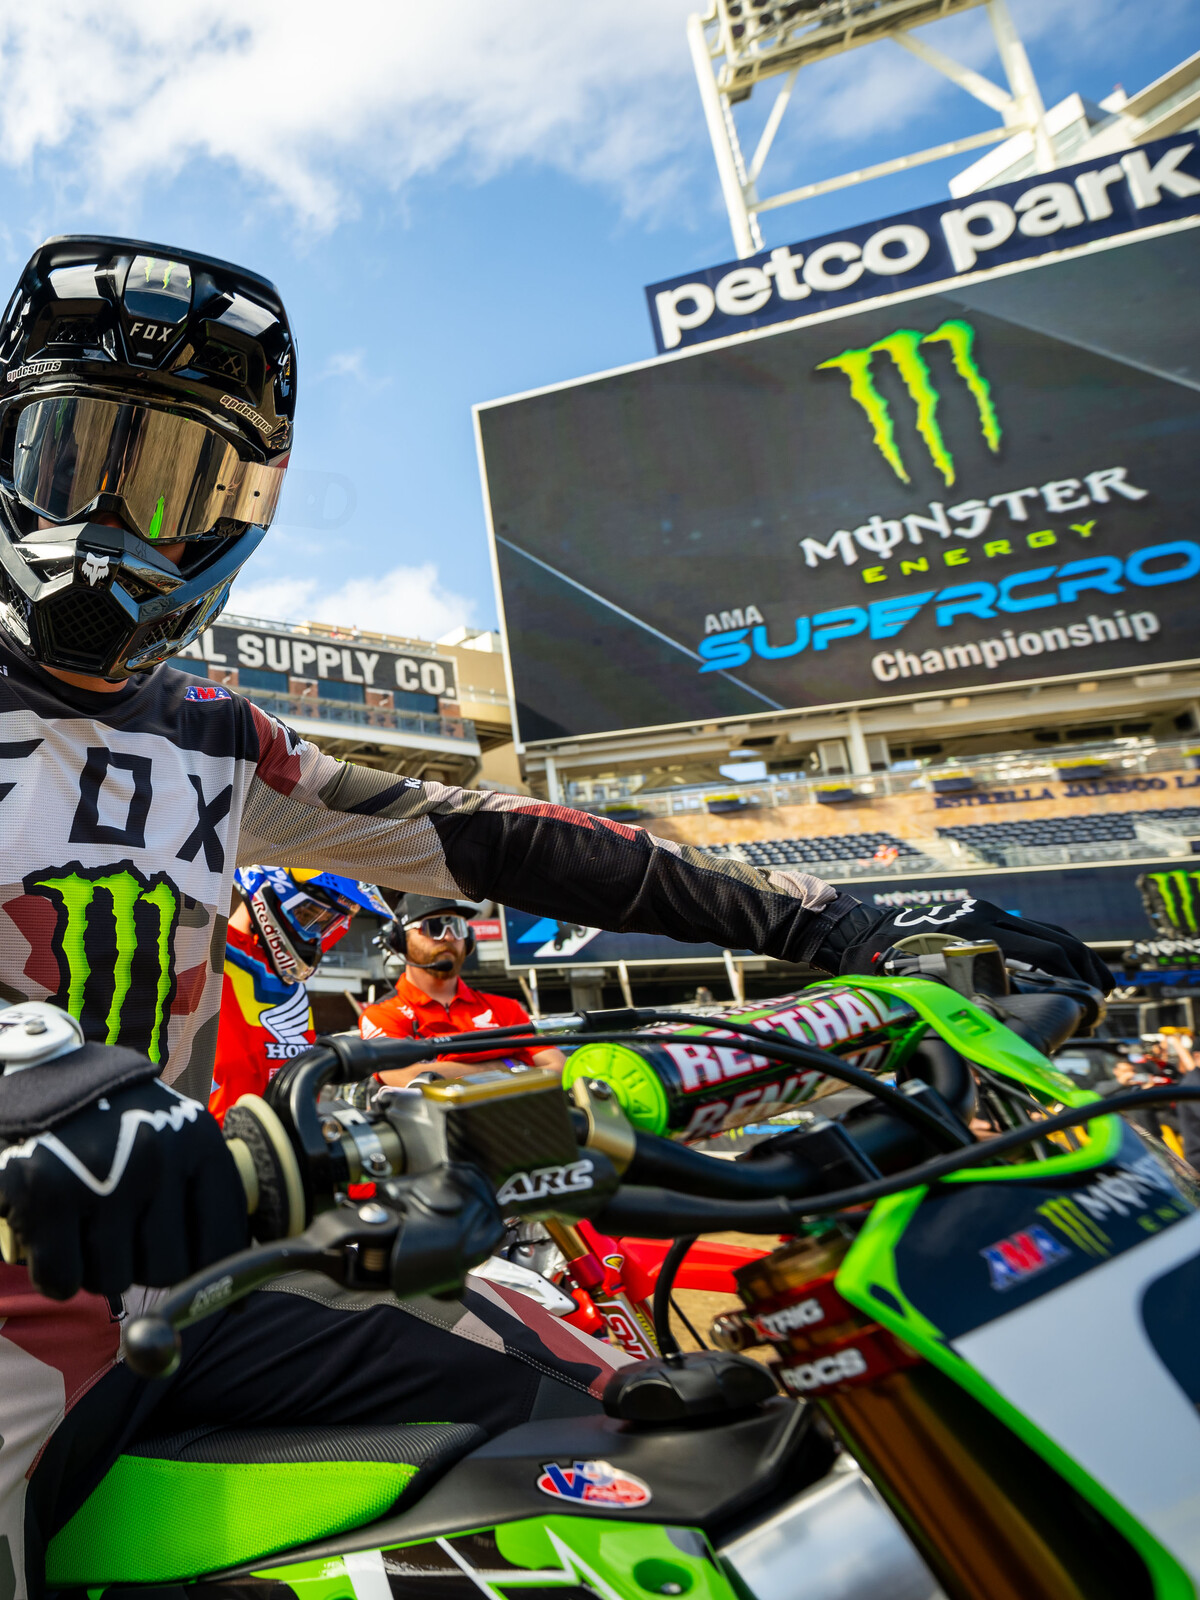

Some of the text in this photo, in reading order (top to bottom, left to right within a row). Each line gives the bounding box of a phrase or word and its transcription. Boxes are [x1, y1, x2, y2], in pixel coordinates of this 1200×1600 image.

[655, 144, 1200, 349] petco park
[129, 322, 173, 343] FOX
[219, 394, 273, 435] apdesigns
[800, 466, 1149, 568] MONSTER
[861, 519, 1098, 585] ENERGY
[704, 605, 765, 634] AMA
[870, 609, 1161, 682] Championship
[236, 633, 379, 685] SUPPLY
[394, 657, 456, 698] CO.
[184, 686, 232, 702] AMA
[495, 1158, 595, 1206] ARC
